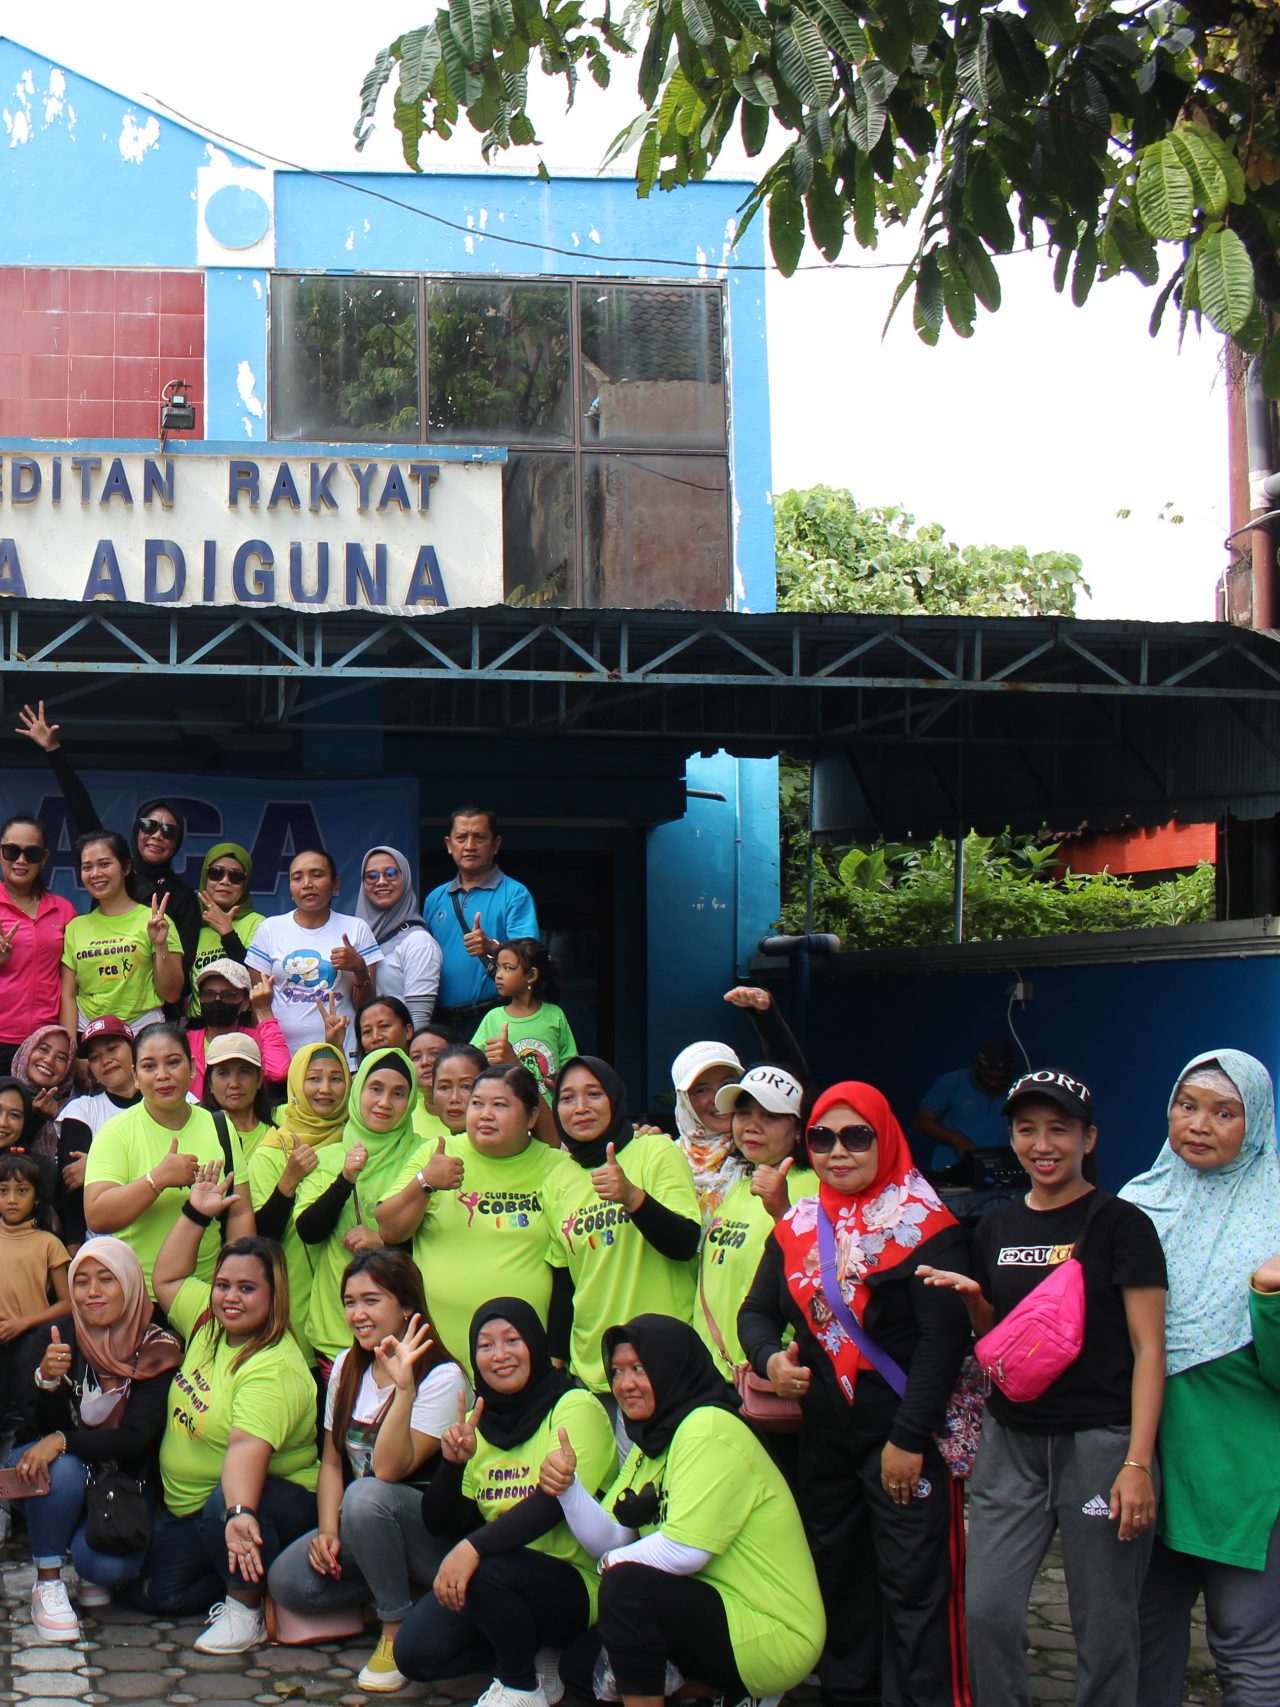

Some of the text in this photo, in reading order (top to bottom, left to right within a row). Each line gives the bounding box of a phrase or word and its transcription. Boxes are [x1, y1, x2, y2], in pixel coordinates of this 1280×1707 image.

[228, 460, 440, 514] RAKYAT
[82, 538, 449, 605] ADIGUNA
[98, 965, 119, 977] FCB
[477, 1197, 542, 1215] COBRA
[573, 1206, 631, 1236] COBRA
